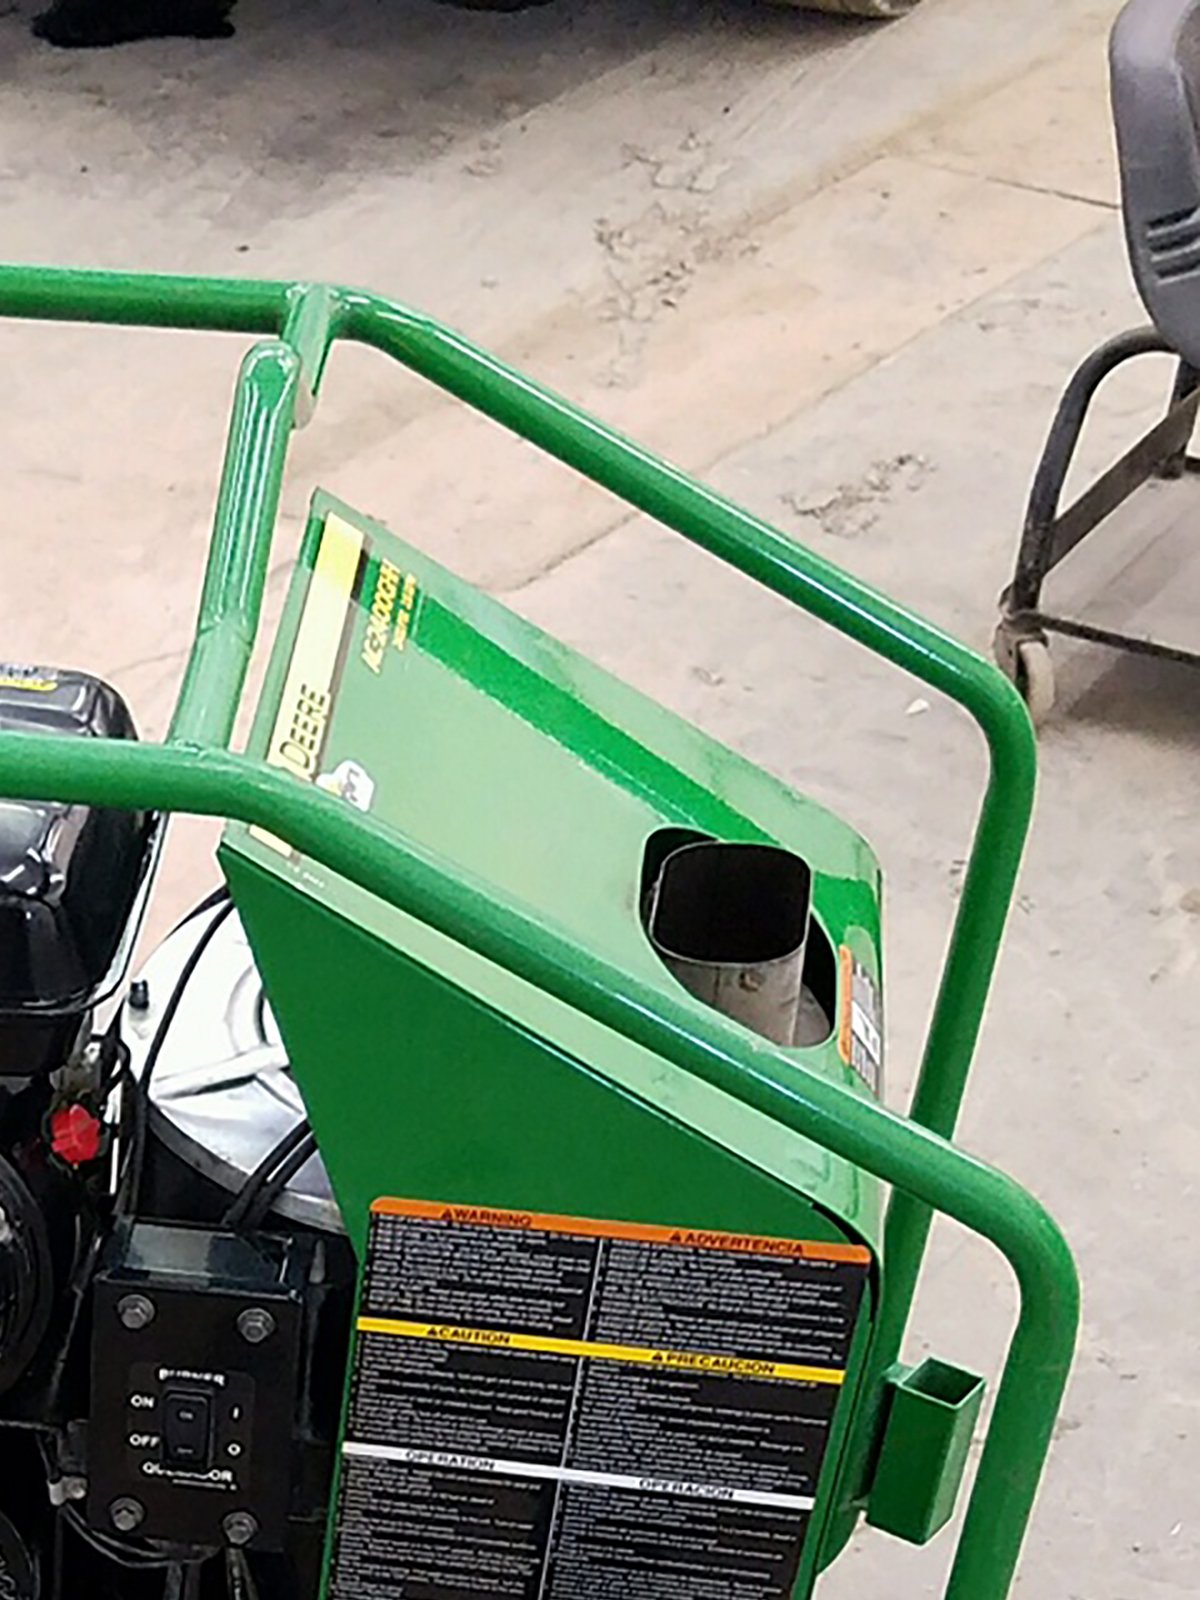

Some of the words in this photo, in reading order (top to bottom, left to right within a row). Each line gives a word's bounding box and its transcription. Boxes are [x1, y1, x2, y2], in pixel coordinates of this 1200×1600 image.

[279, 683, 326, 771] DEERE
[453, 1208, 532, 1227] WARNING
[685, 1232, 804, 1255] ADVERTENCIA
[438, 1326, 511, 1344] CAUTION
[130, 1394, 155, 1409] ON
[129, 1433, 161, 1448] OFF
[405, 1450, 496, 1471] OPERATION
